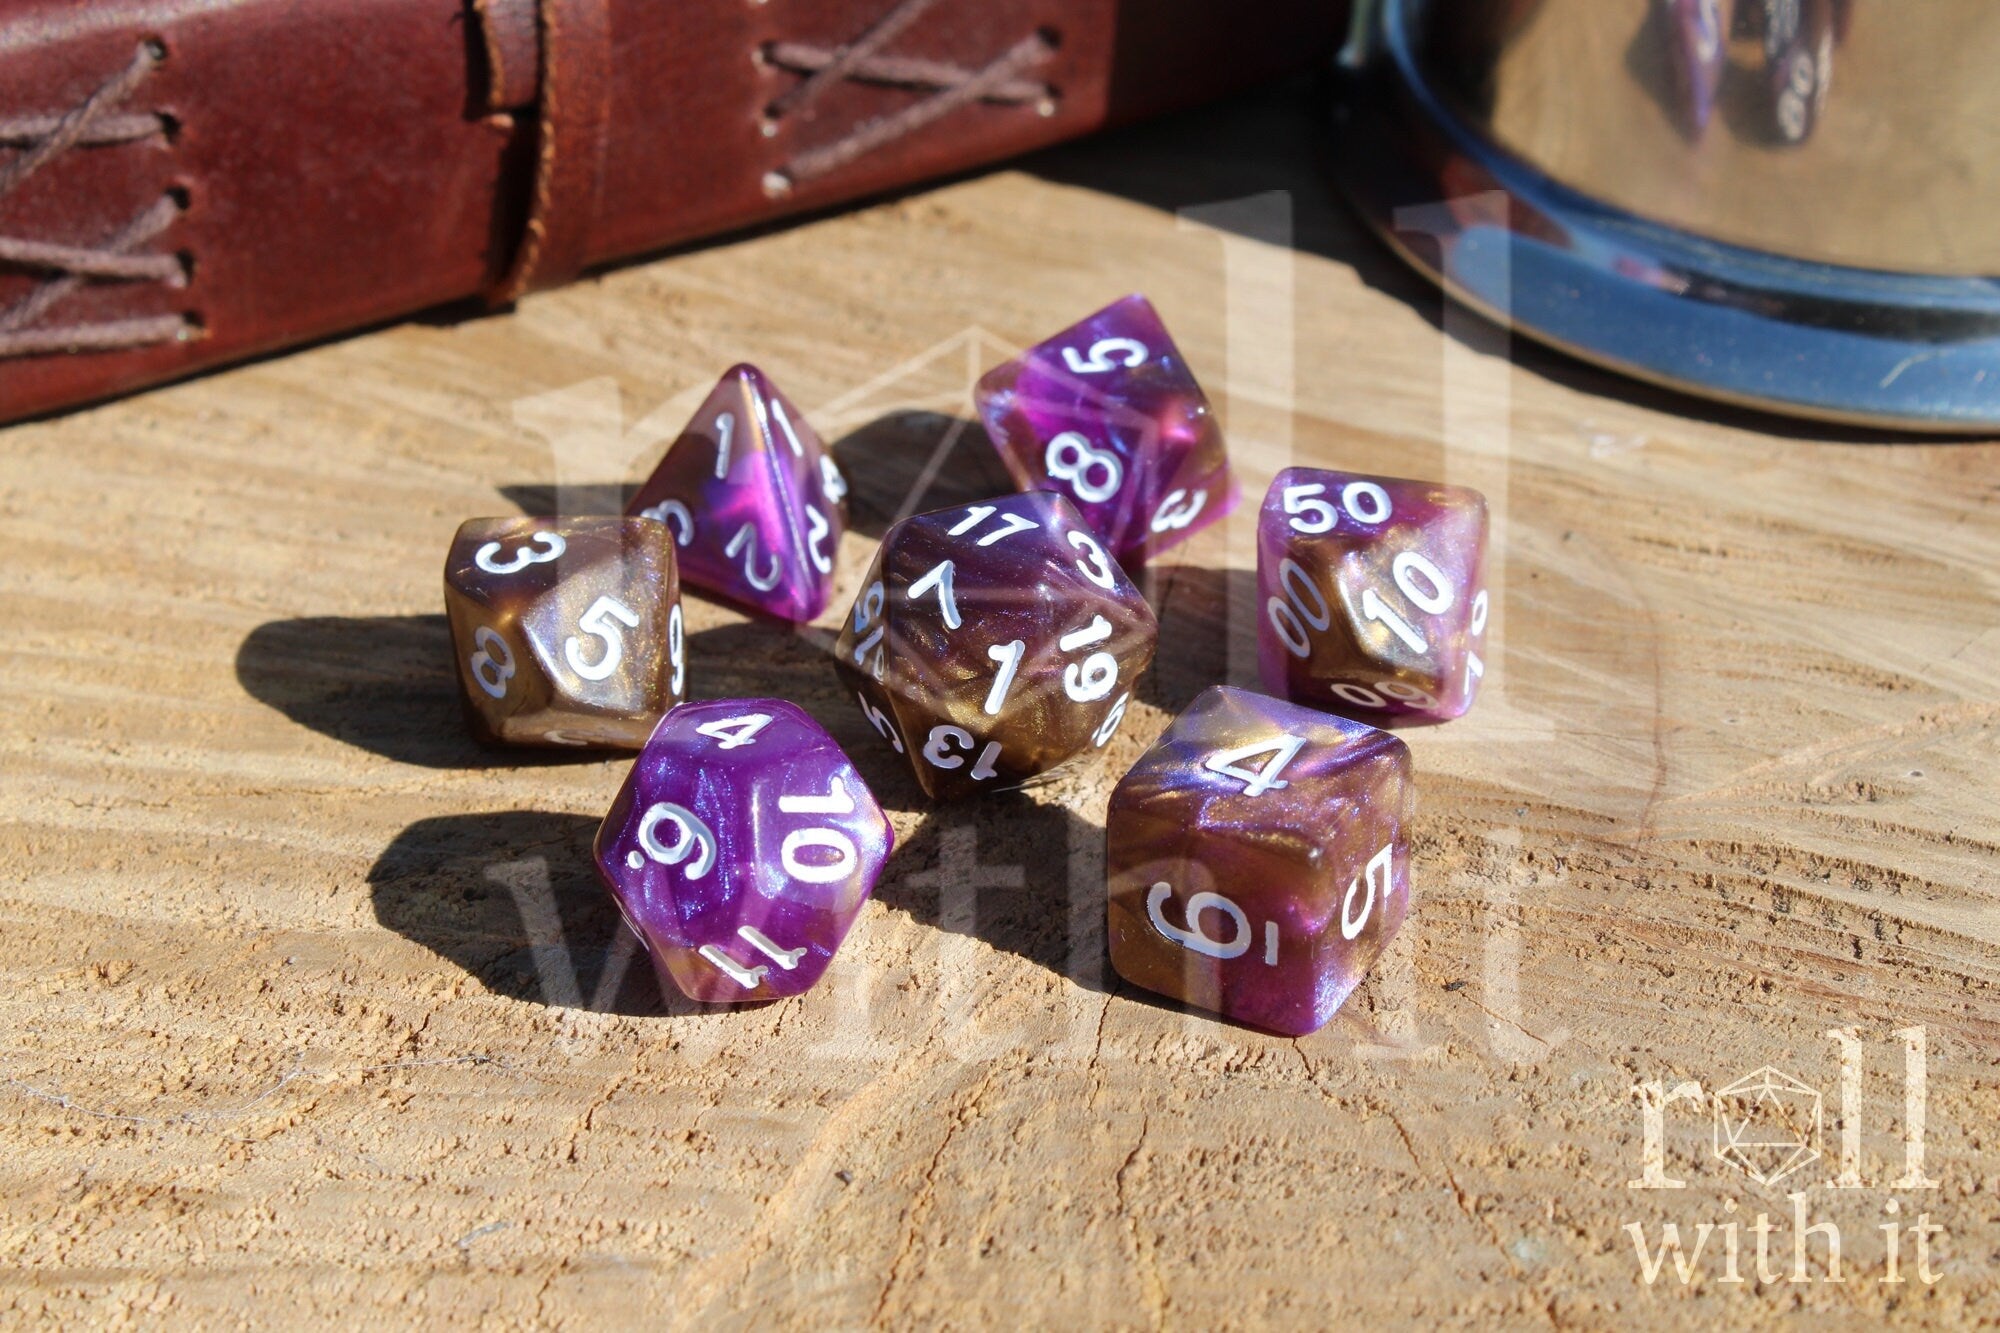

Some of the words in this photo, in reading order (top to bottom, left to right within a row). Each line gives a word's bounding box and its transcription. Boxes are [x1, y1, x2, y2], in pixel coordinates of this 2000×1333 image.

[1062, 337, 1149, 375] 5
[716, 413, 734, 479] 1
[771, 399, 803, 457] 1
[1045, 431, 1123, 504] 8
[805, 504, 831, 574] 2
[947, 506, 1040, 547] 17
[1283, 482, 1393, 534] 50
[475, 532, 567, 575] 3
[725, 524, 782, 591] 2
[1067, 530, 1115, 590] 3
[1267, 558, 1331, 659] 00
[1362, 551, 1456, 655] 10
[470, 627, 516, 699] 8
[565, 596, 639, 681] 5
[1059, 614, 1119, 703] 19
[984, 639, 1026, 715] 1
[696, 713, 773, 750] 4
[1204, 733, 1308, 798] 4
[778, 775, 858, 884] 10
[1341, 842, 1394, 941] 5
[698, 924, 808, 990] 11
